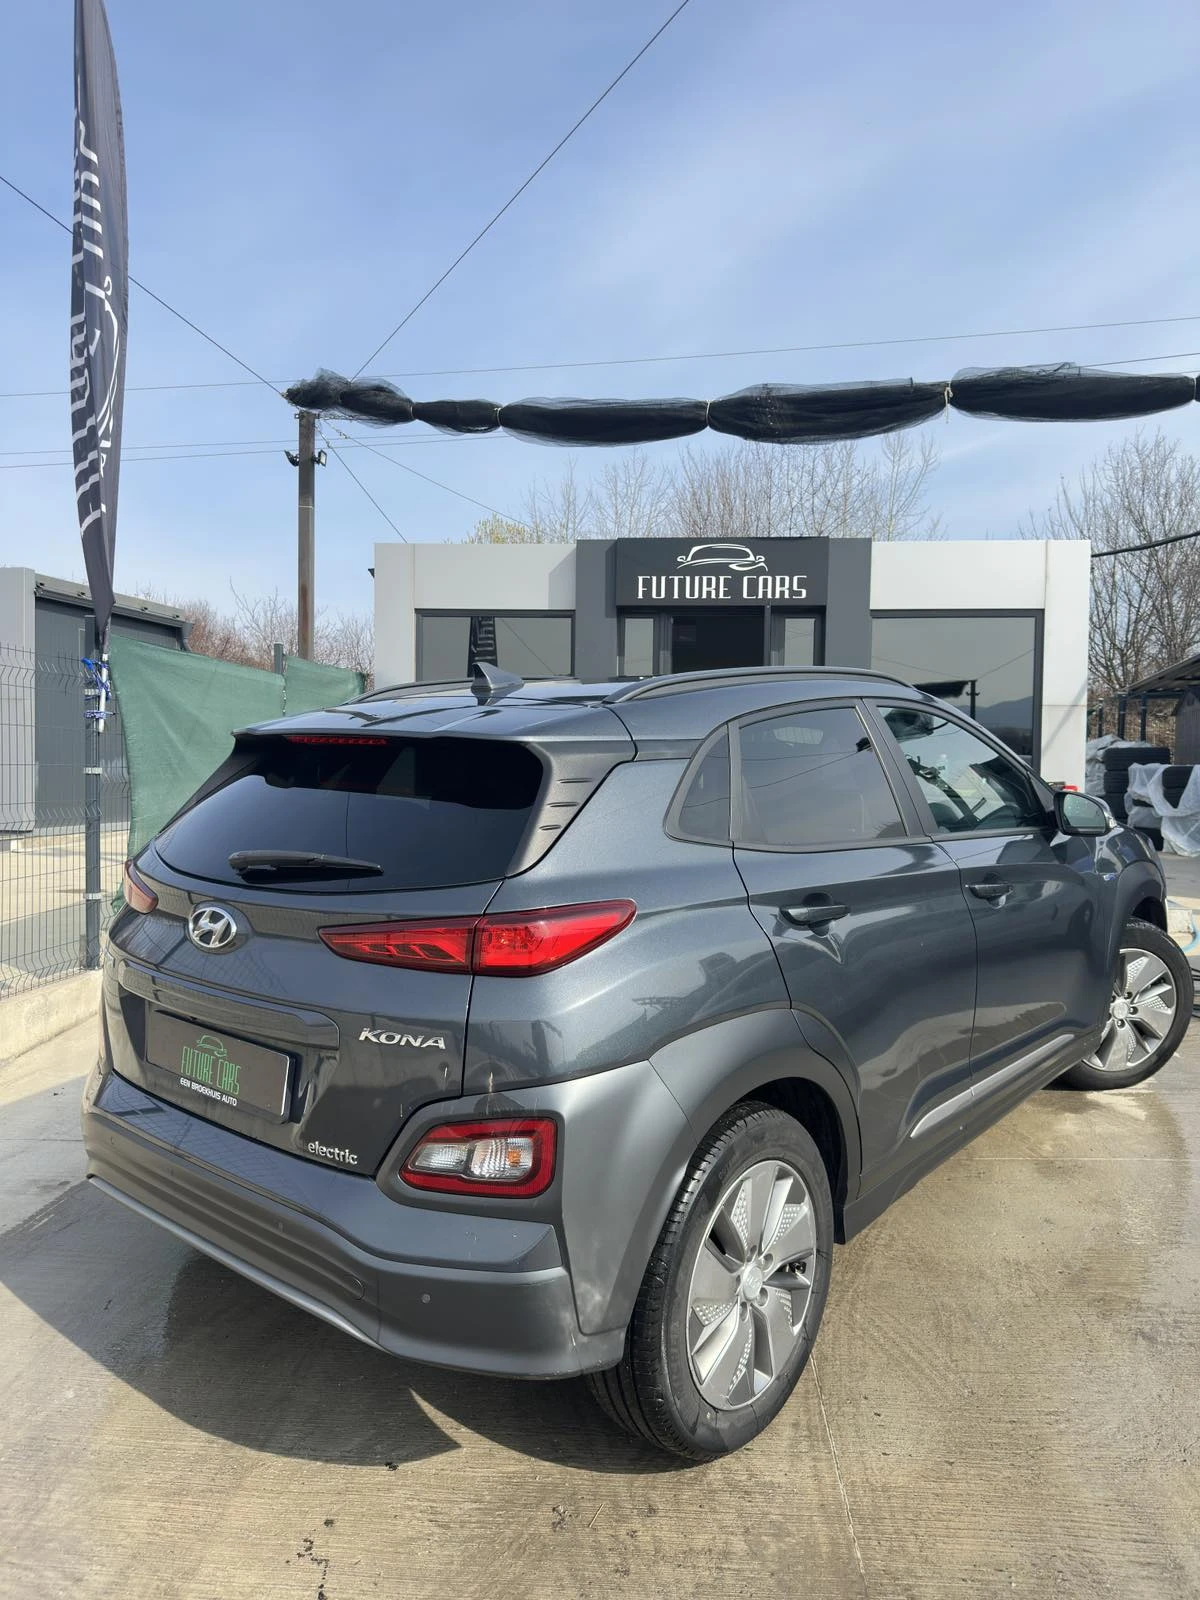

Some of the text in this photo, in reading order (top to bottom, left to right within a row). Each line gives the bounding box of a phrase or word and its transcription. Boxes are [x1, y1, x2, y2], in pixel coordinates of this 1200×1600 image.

[637, 575, 807, 599] FUTURE CARS
[359, 1028, 446, 1049] KONA
[181, 1046, 241, 1095] FUTURE CARS
[180, 1077, 191, 1088] EEN
[221, 1094, 238, 1106] AUTO
[308, 1141, 358, 1165] electric
